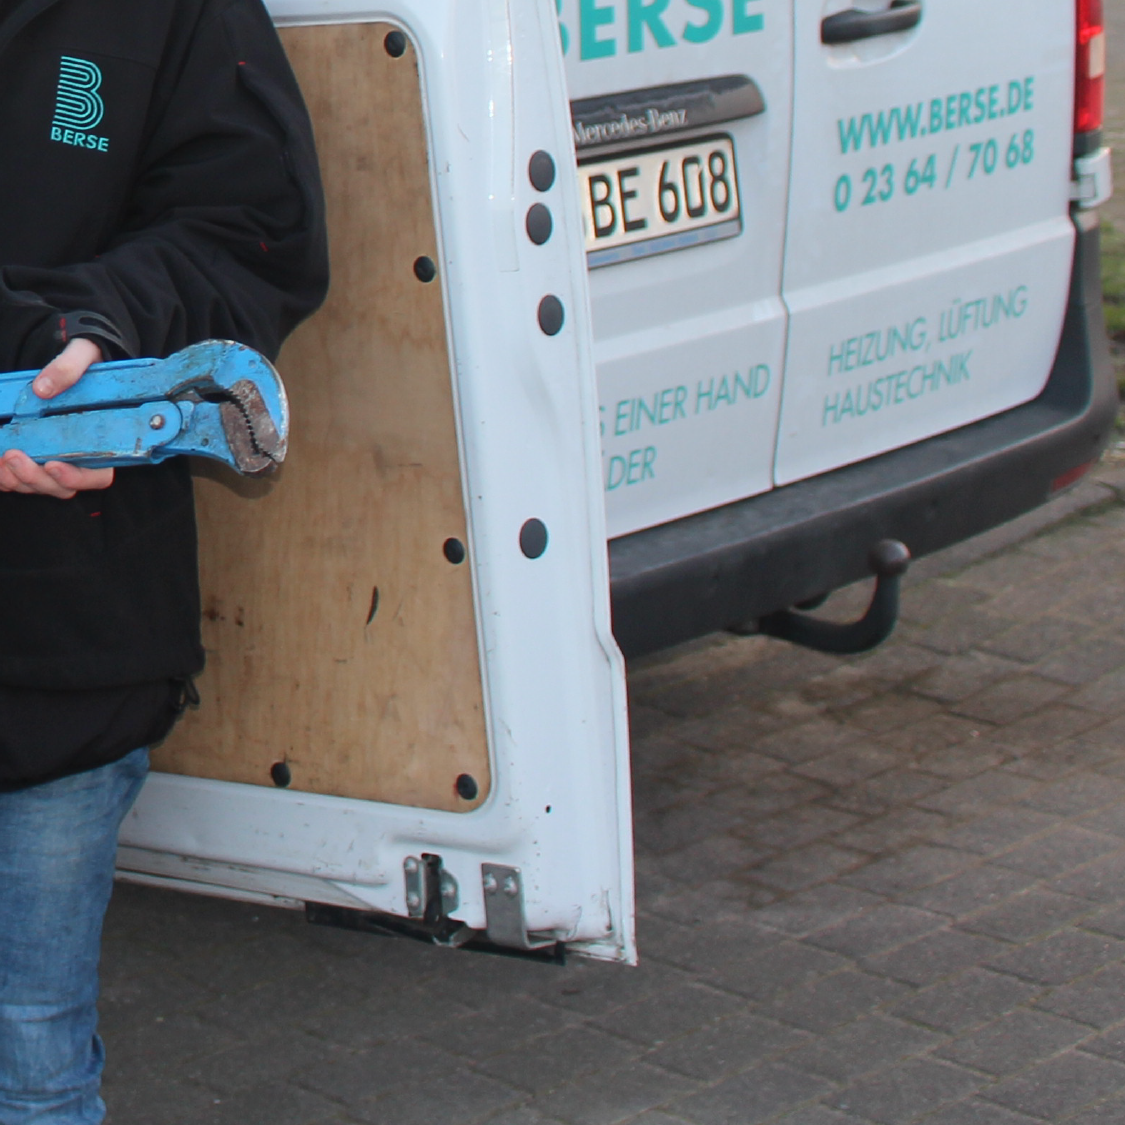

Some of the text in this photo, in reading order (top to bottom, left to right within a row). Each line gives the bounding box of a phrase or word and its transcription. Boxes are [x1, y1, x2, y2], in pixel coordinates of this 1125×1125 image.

[50, 126, 110, 153] BERSE
[837, 76, 1035, 156] WWW.BERSE.DE
[588, 150, 732, 240] BE 608
[860, 163, 895, 207] 23
[903, 153, 937, 196] 64
[967, 138, 998, 179] 70
[1005, 128, 1035, 169] 68
[827, 284, 1029, 379] HEIZUNG, LÜFTUNG
[614, 385, 688, 437] EINER
[695, 363, 772, 415] HAND
[822, 349, 974, 427] HAUSTECHNIK
[601, 445, 657, 492] DER
